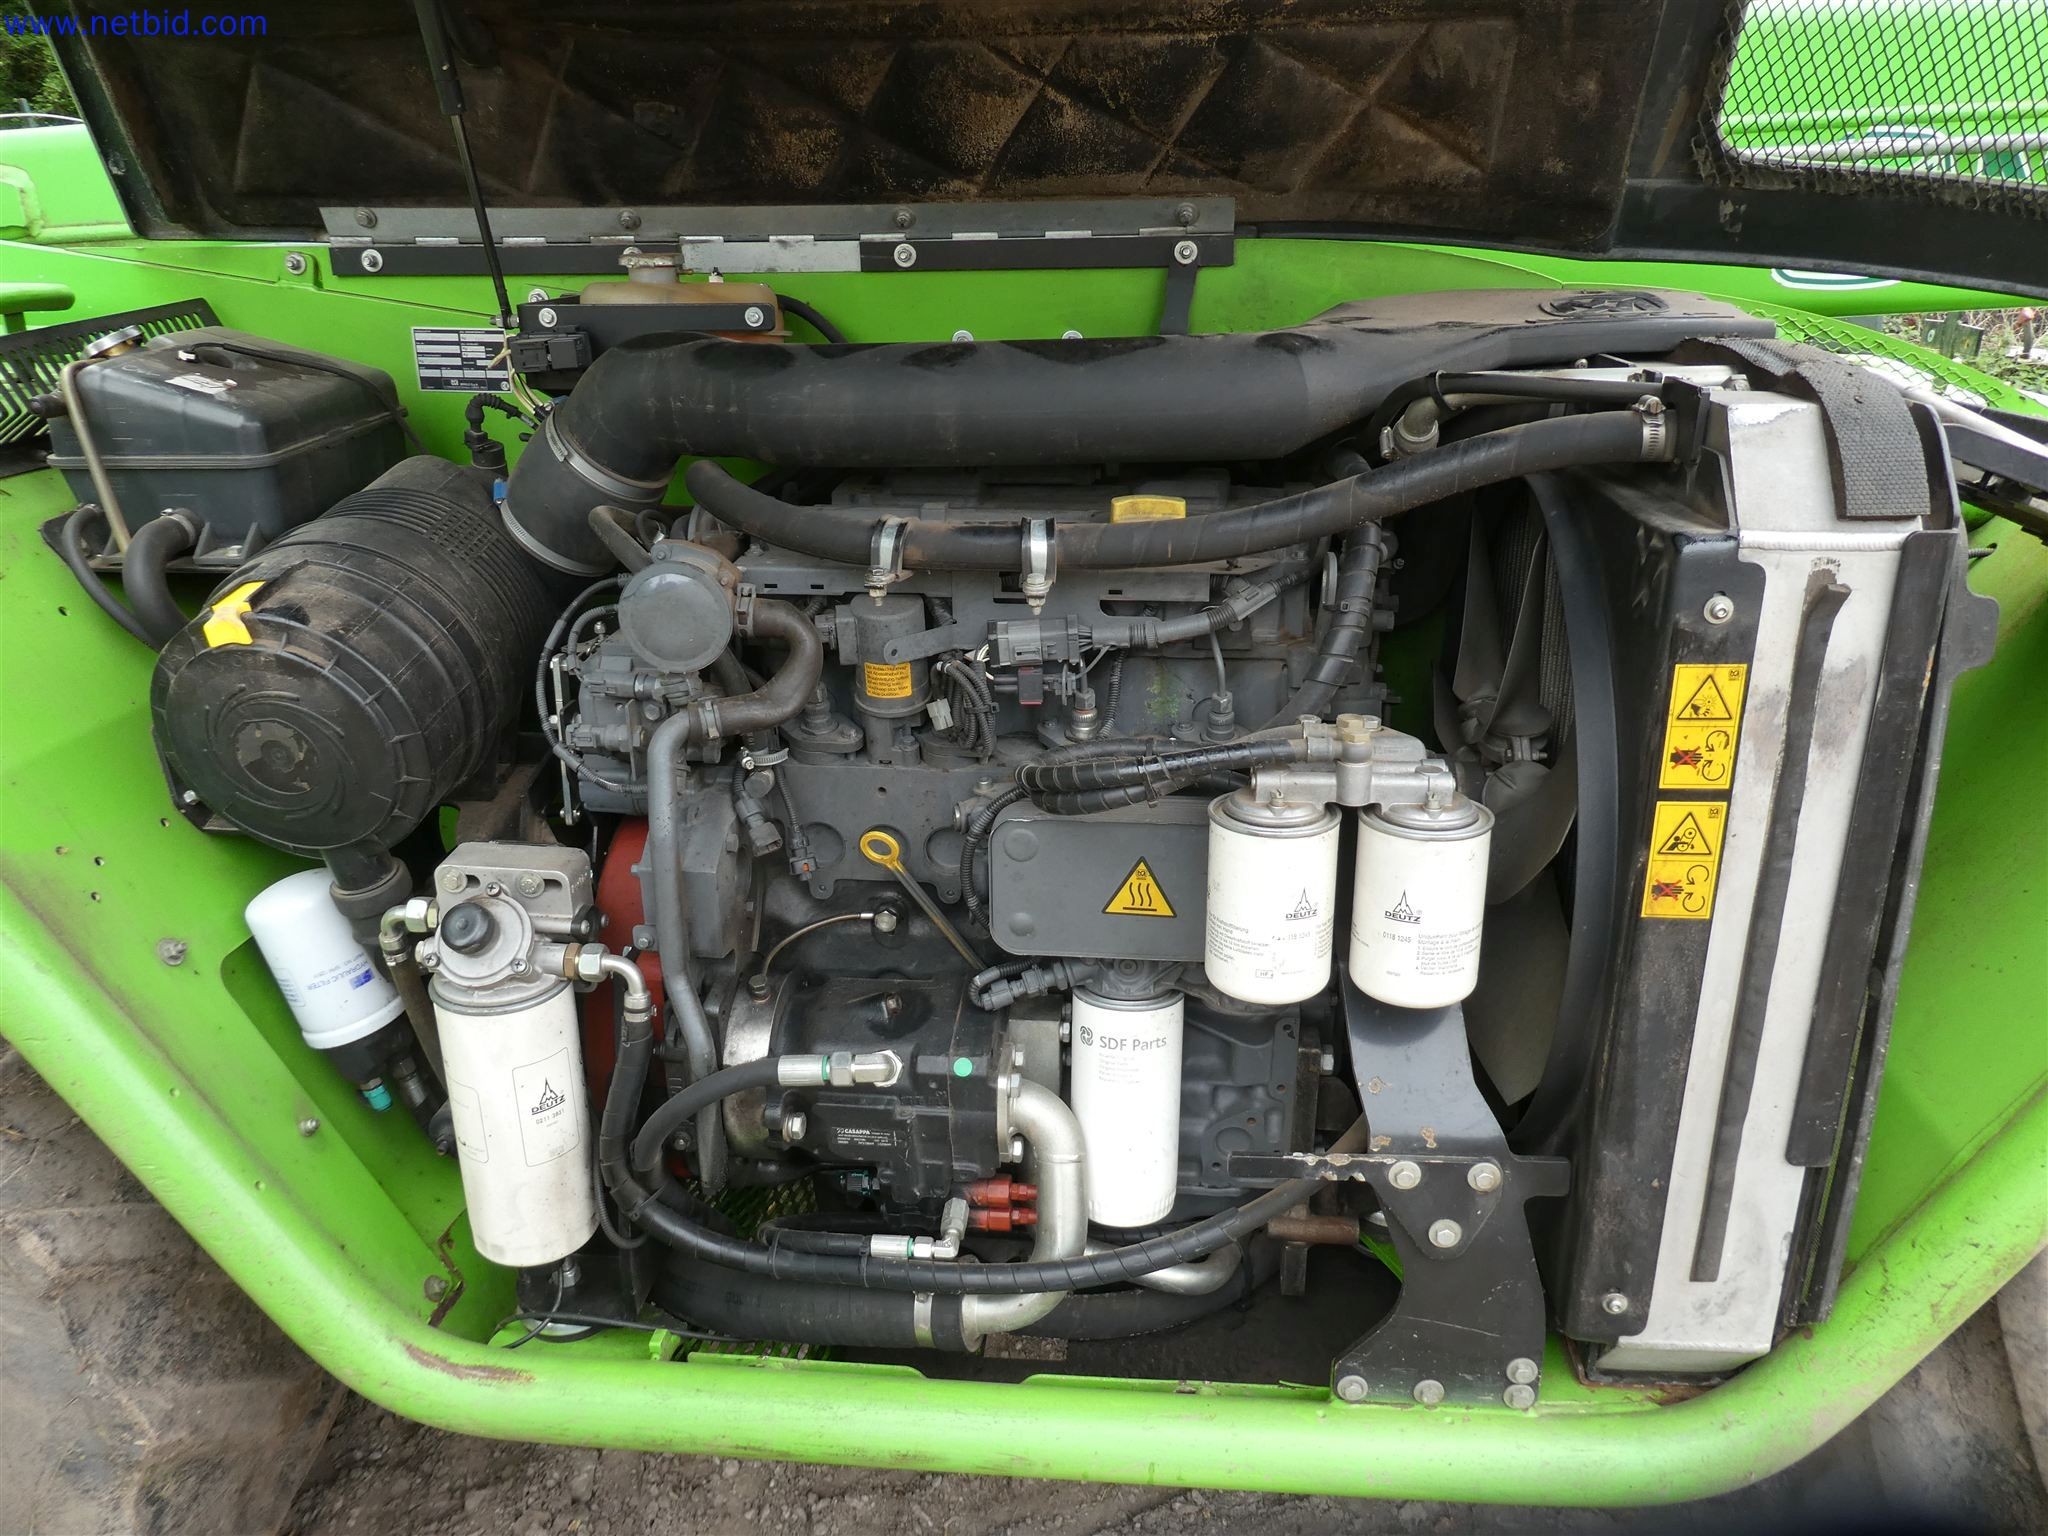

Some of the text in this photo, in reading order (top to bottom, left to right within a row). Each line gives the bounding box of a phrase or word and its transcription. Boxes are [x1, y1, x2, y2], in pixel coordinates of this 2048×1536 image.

[1285, 909, 1318, 920] DEUTZ
[1384, 911, 1421, 923] DEUTZ
[1382, 931, 1412, 943] 0118 1245
[1099, 1035, 1167, 1051] SDF Parts
[531, 1094, 565, 1114] DEUTZ
